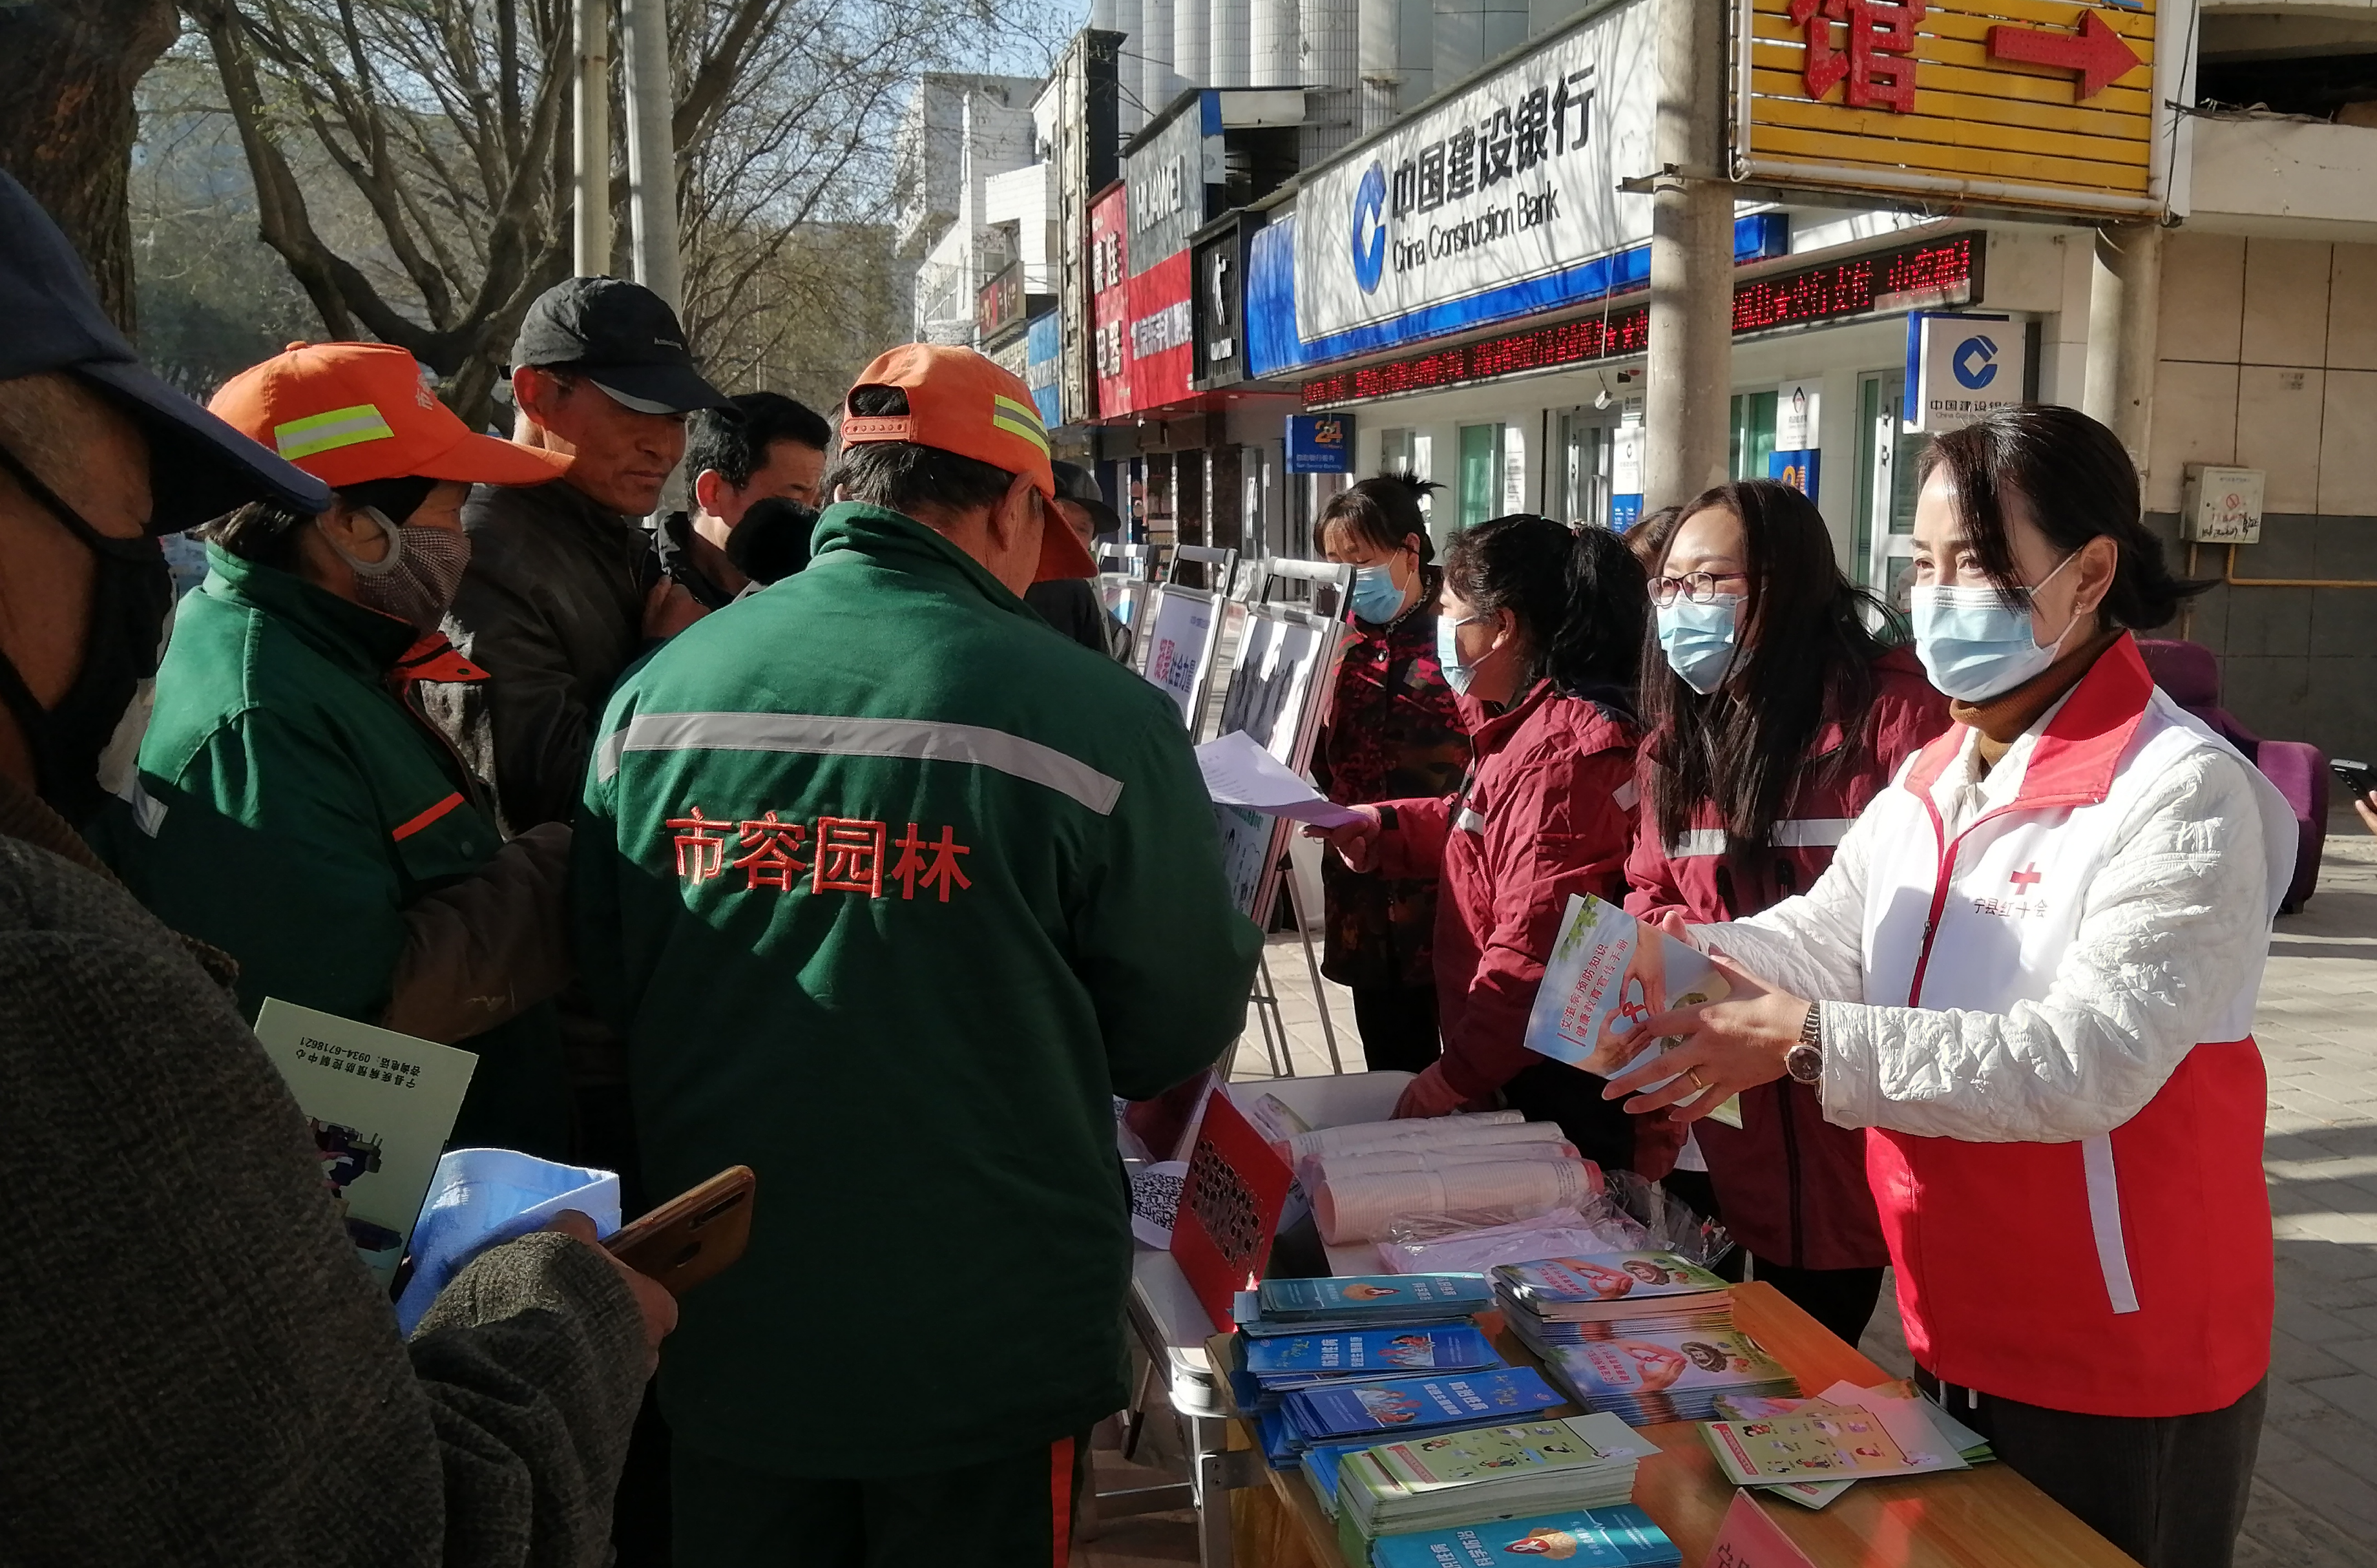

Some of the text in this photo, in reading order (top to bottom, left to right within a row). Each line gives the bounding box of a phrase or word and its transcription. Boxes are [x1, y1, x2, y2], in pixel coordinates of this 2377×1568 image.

[1788, 0, 1925, 113] 馆
[1392, 64, 1595, 223] 中国建设银行
[1135, 155, 1184, 235] HUAWEI
[1393, 180, 1560, 273] China Construction Bank
[1931, 400, 2009, 412] 中国建设银
[665, 806, 972, 903] 市容园林
[1974, 897, 2049, 919] 宁县红十会
[1559, 943, 1609, 1032] 艾滋病预防知识
[1575, 937, 1629, 1039] 健康教育宣传手册
[295, 1048, 417, 1090] 宁县疾病预防控制中心
[1455, 1530, 1496, 1567] 科学防治
